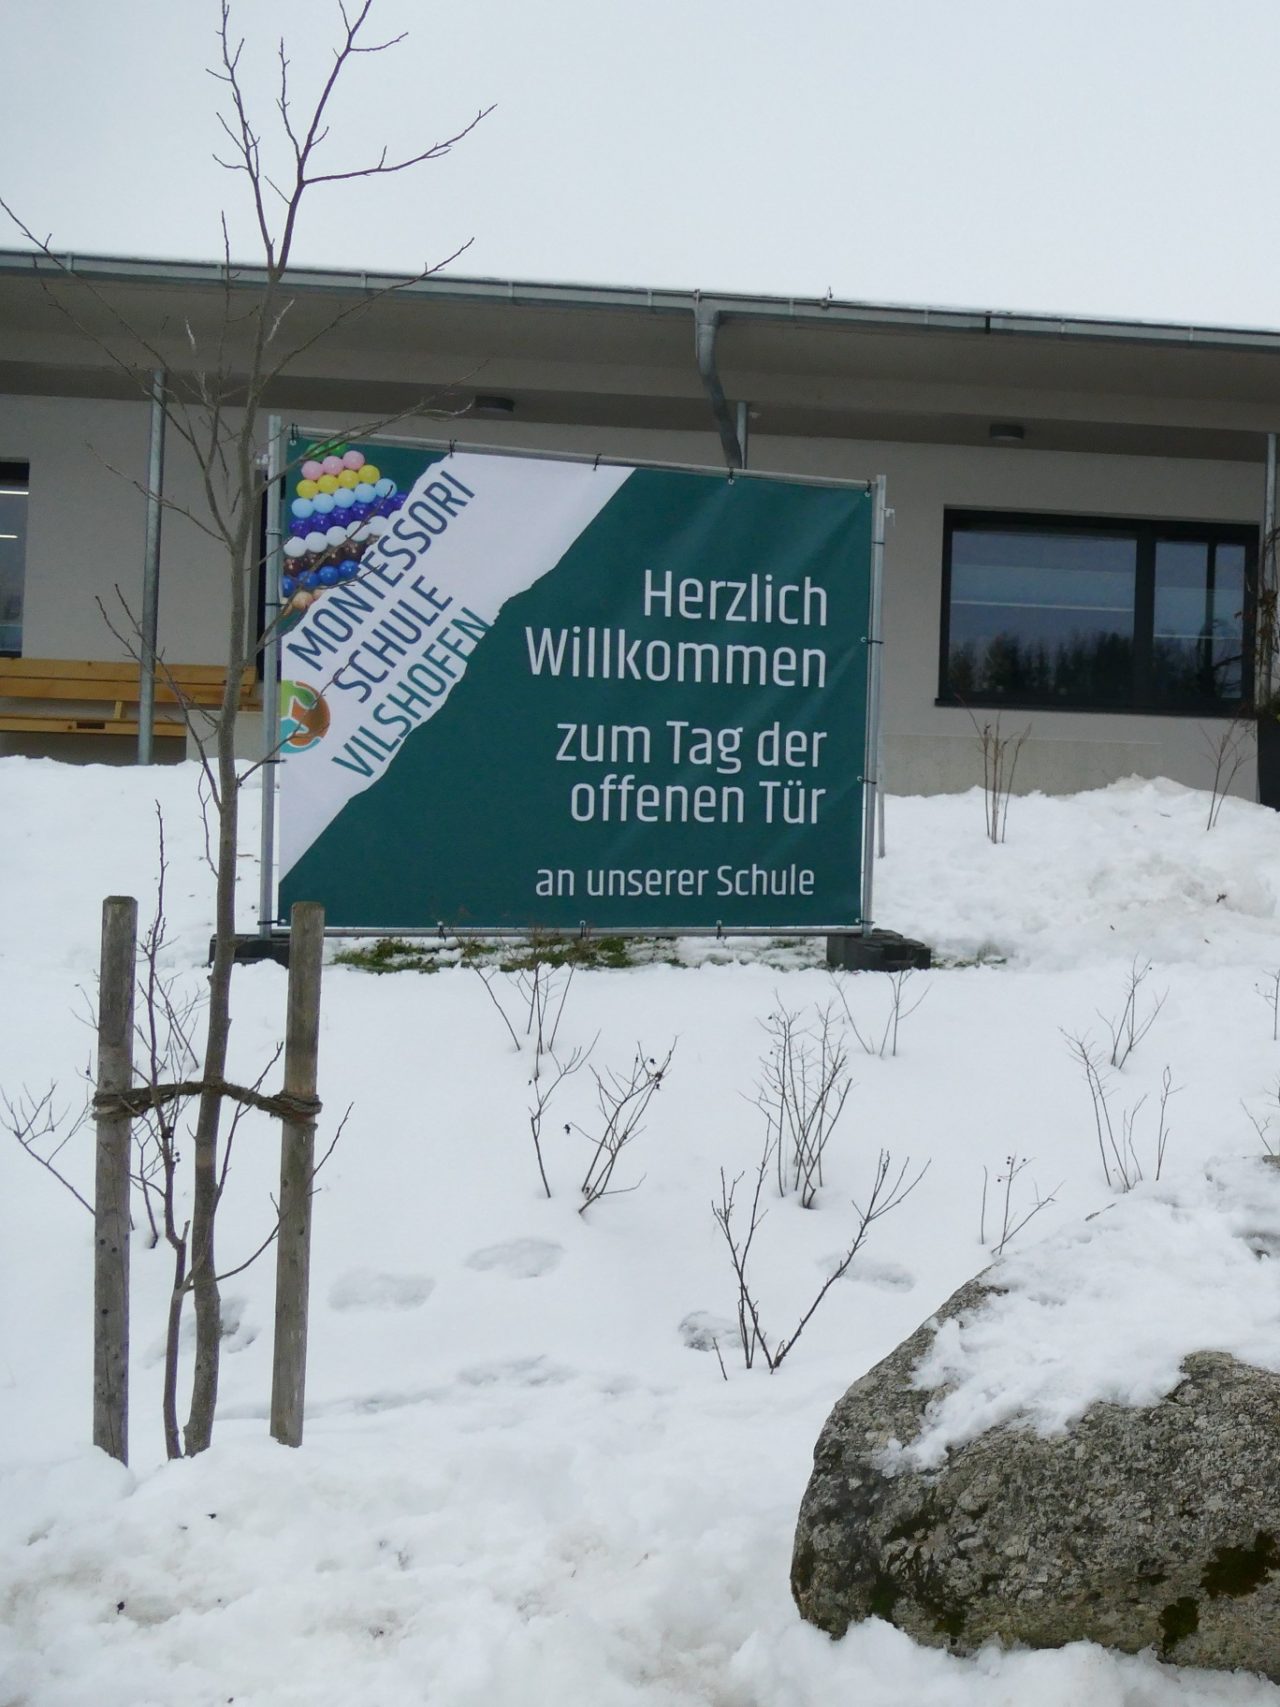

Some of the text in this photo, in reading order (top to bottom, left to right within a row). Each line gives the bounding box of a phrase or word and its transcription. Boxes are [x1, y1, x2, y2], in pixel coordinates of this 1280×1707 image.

[286, 470, 476, 672] MONTESSORI
[644, 569, 827, 626] Herzlich
[332, 574, 453, 704] SCHULE
[525, 625, 827, 688] Willkommen
[330, 606, 492, 778] VILSHOFEN
[555, 720, 828, 775] zum Tag der
[570, 774, 827, 825] offenen Tür
[535, 863, 815, 896] an unserer Schule
